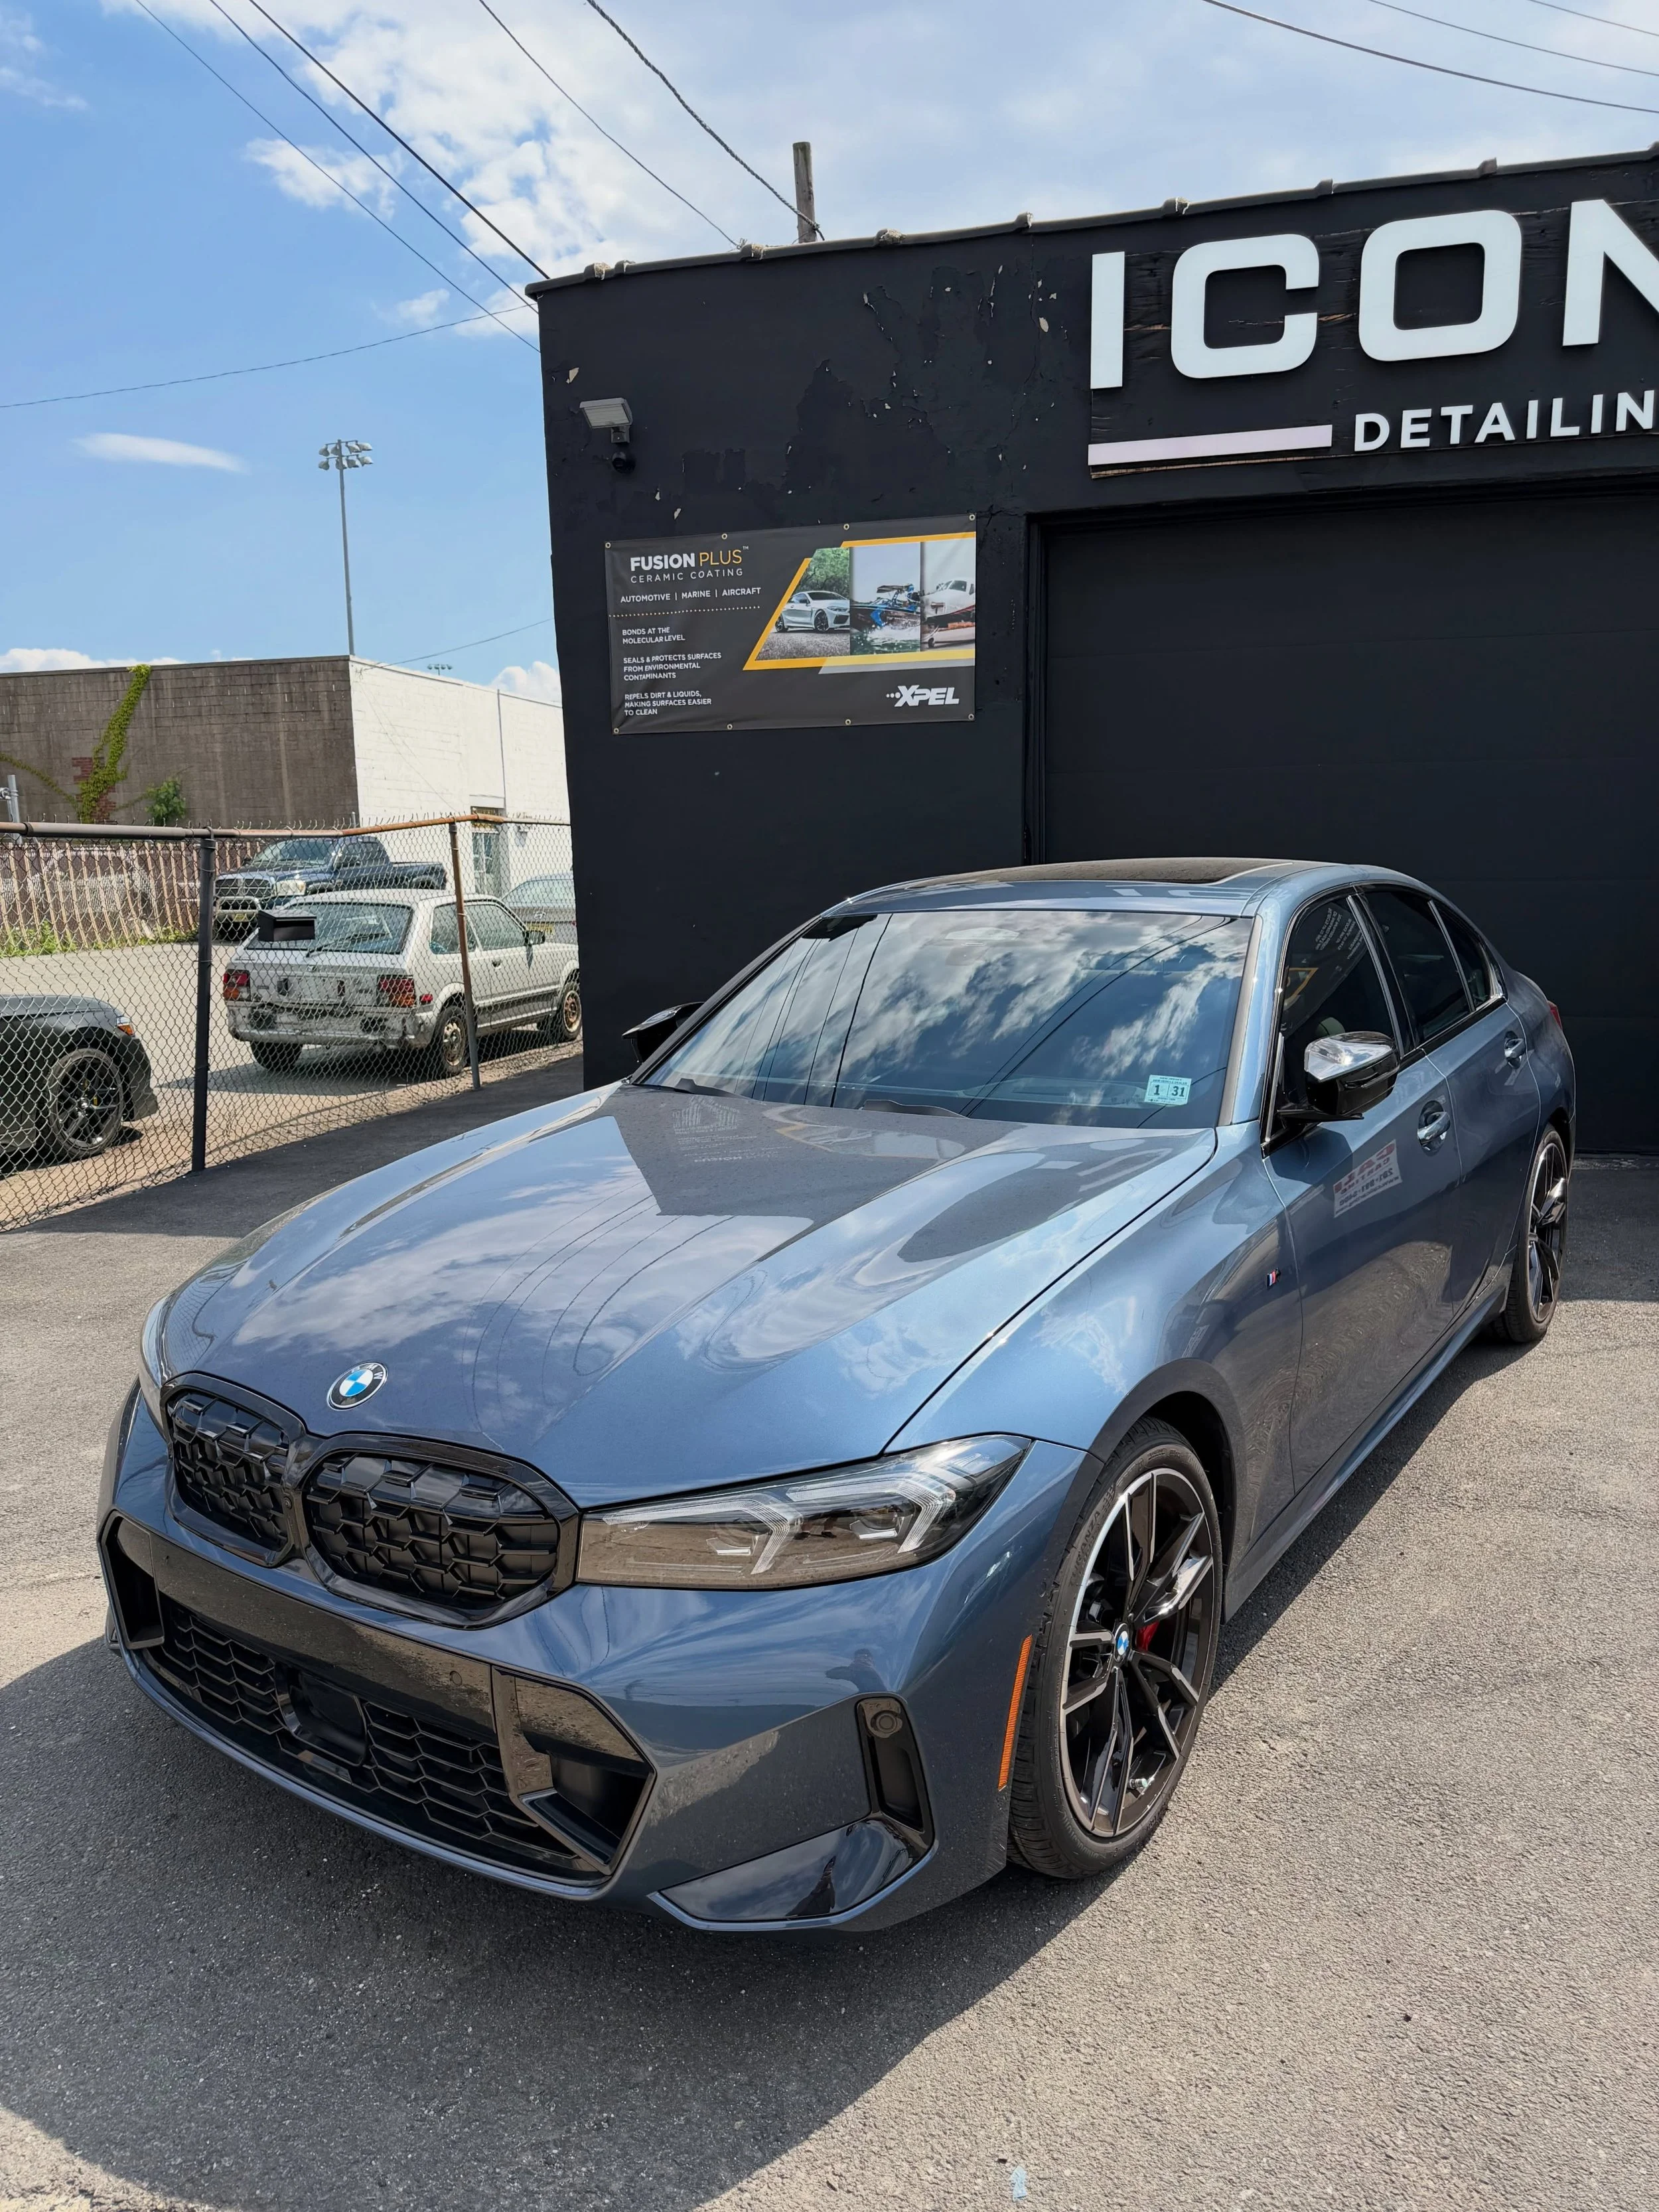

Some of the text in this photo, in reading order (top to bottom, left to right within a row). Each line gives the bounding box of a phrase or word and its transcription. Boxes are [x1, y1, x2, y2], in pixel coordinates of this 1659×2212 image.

[630, 553, 695, 571] FUSION
[630, 568, 743, 583] CERAMIC COATING
[620, 587, 761, 603] AUTOMOTIVE MARINE AIRCRAFT
[622, 636, 664, 644] MOLECULAR
[645, 662, 701, 672] ENVIRONMENTAL
[624, 672, 676, 681] CONTAMINANTS
[894, 684, 960, 707] XPEL
[1154, 1084, 1160, 1095] 1
[1171, 1086, 1185, 1097] 31
